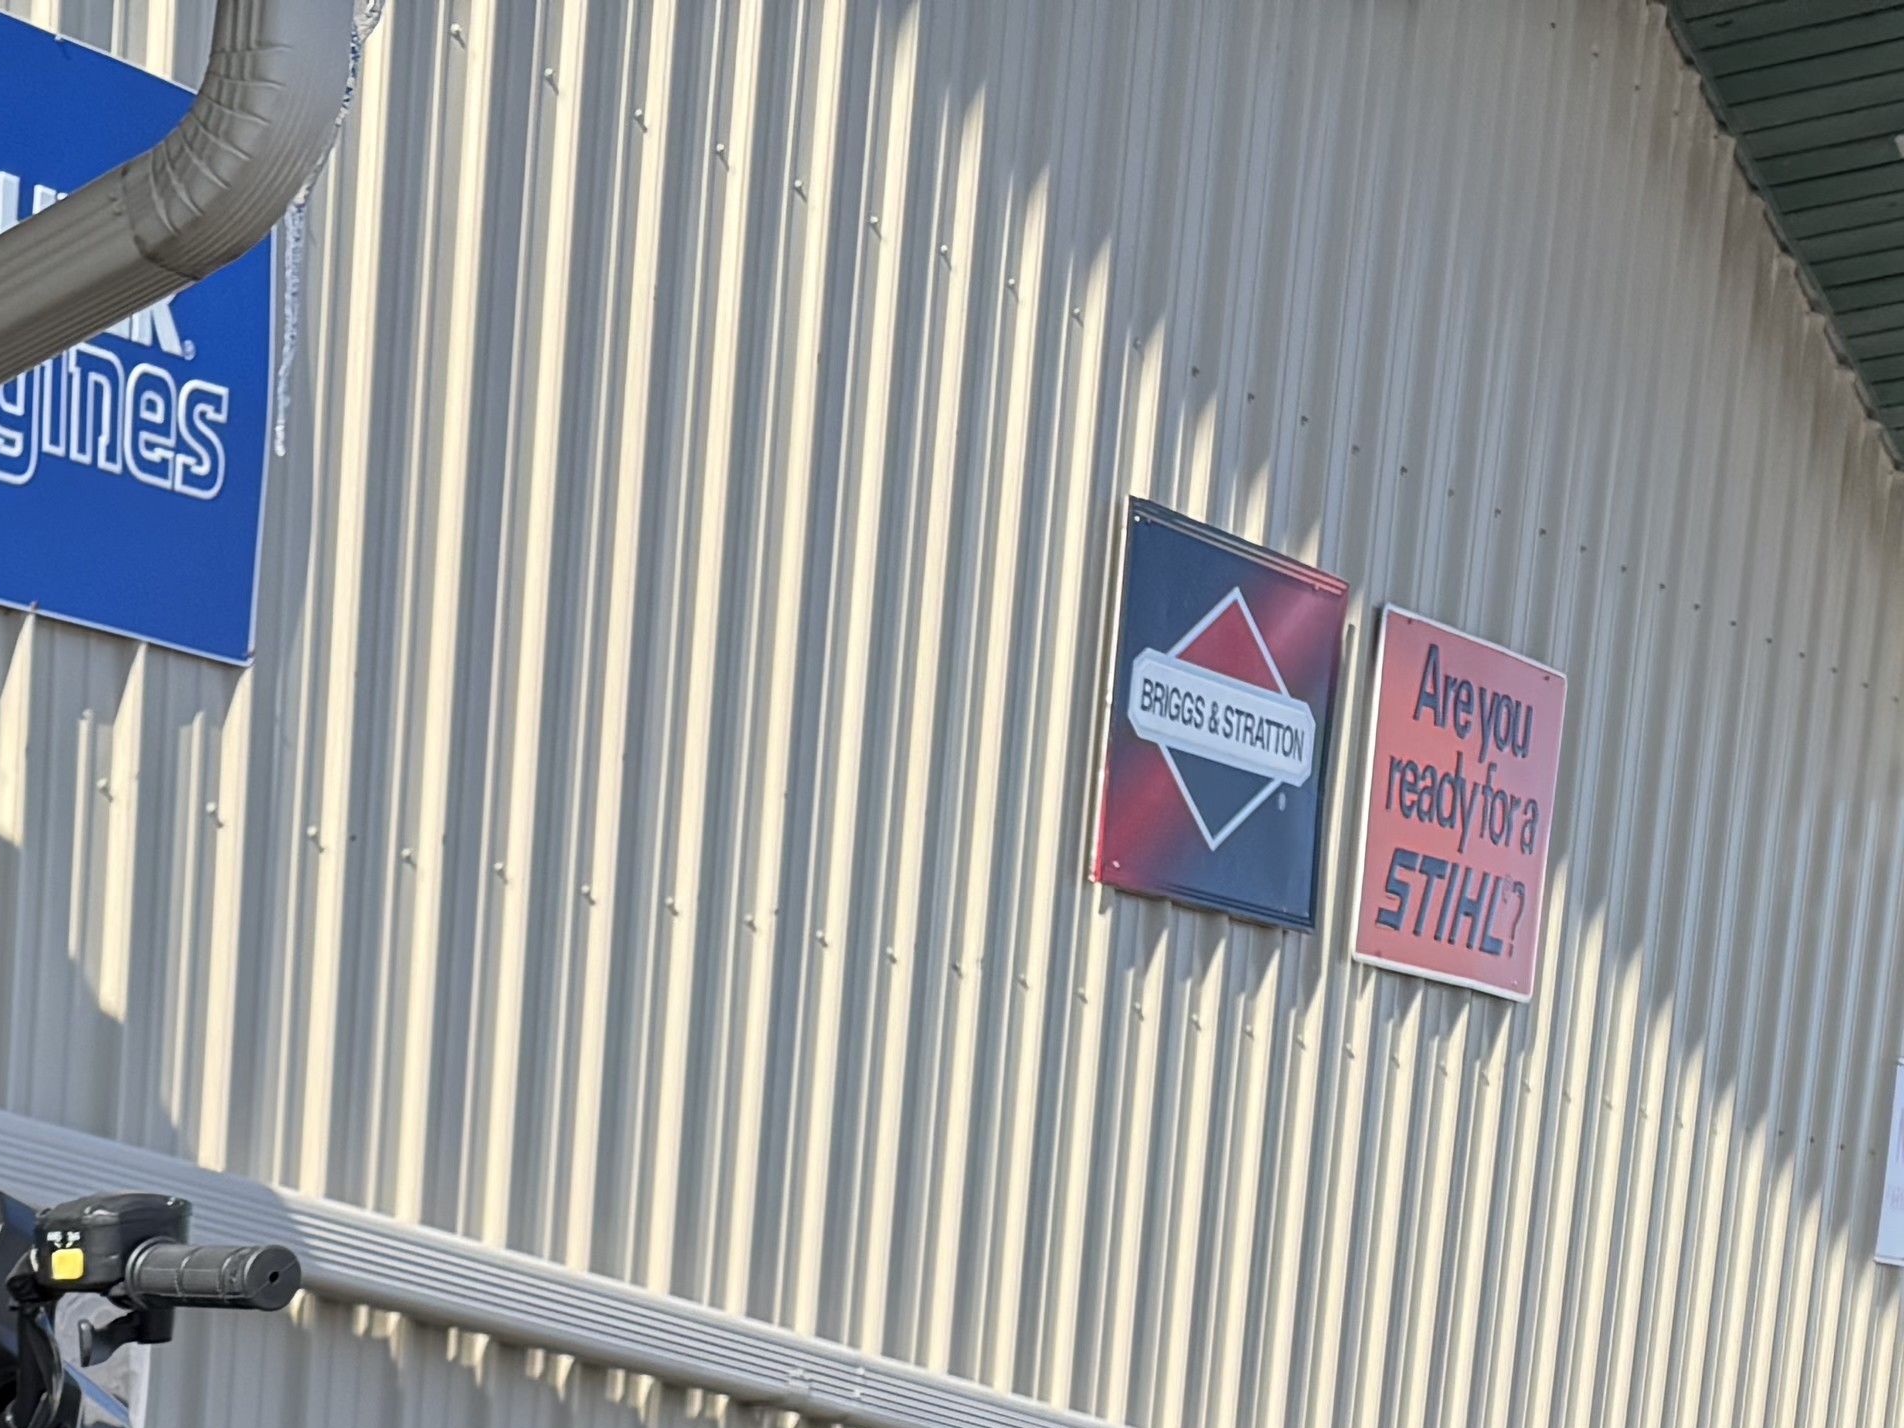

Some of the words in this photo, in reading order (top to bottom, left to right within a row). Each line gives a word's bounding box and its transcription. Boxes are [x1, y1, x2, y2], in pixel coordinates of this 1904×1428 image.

[1141, 676, 1205, 732] BRIGGS
[1208, 704, 1220, 736] &
[1223, 706, 1305, 763] STRATTON
[1413, 643, 1475, 740] Are
[1478, 685, 1533, 763] you
[1385, 751, 1479, 855] ready
[1480, 763, 1519, 847] for
[1520, 797, 1540, 856] a
[1375, 847, 1527, 958] STIHL?
